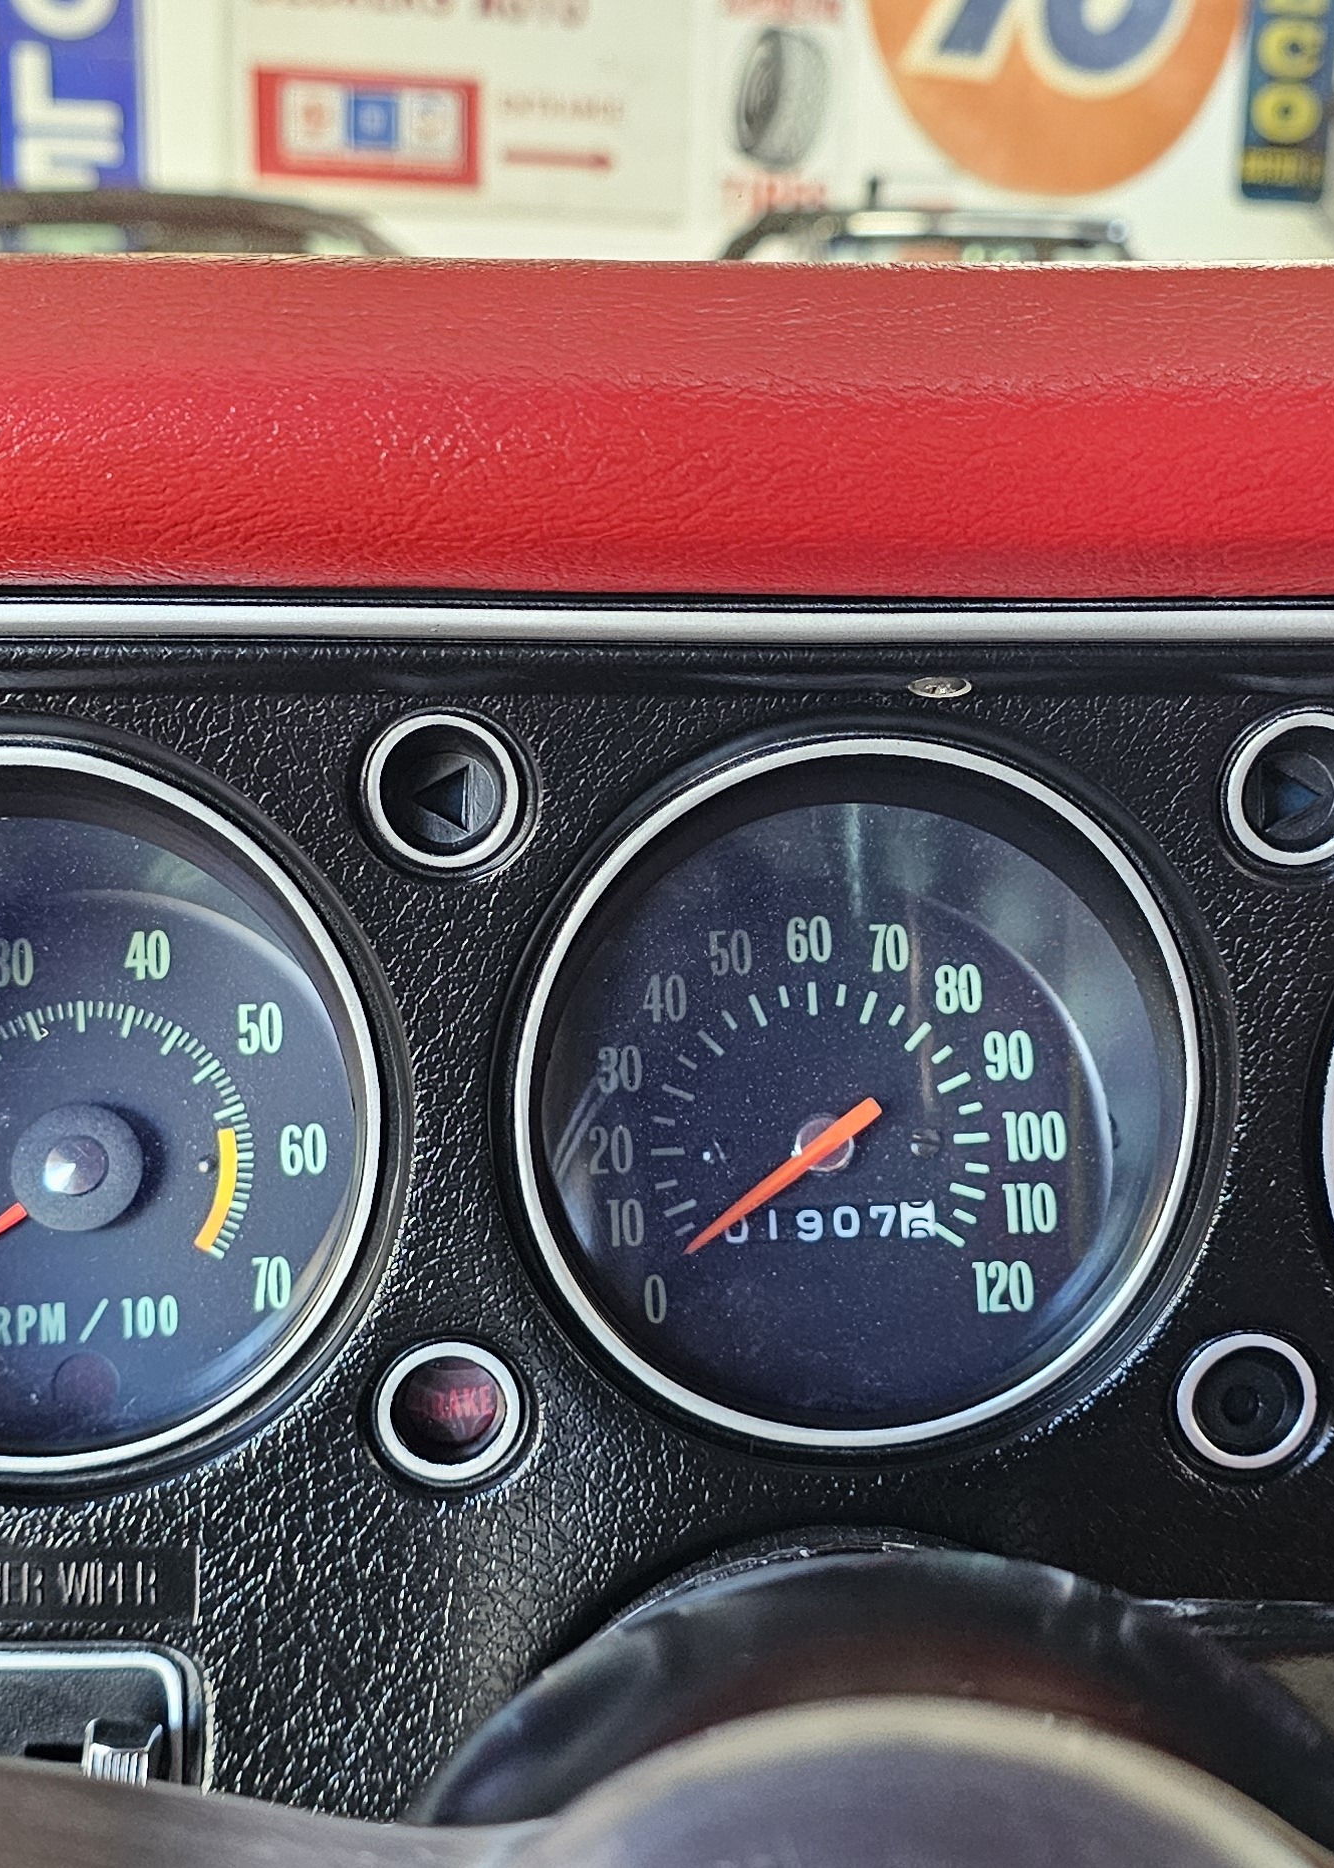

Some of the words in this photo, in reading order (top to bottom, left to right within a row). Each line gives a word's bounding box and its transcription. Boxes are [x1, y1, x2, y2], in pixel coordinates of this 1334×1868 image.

[123, 929, 170, 981] 40
[709, 929, 752, 976] 50
[786, 916, 831, 963] 60
[869, 923, 909, 972] 70
[643, 974, 687, 1022] 40
[935, 963, 982, 1013] 80
[237, 1002, 283, 1054] 50
[597, 1045, 642, 1091] 30
[984, 1029, 1034, 1081] 90
[280, 1124, 327, 1176] 60
[589, 1127, 633, 1175] 20
[1002, 1110, 1066, 1161] 100
[608, 1199, 645, 1247] 10
[1002, 1183, 1058, 1234] 110
[251, 1257, 292, 1313] 70
[644, 1274, 666, 1324] 0
[972, 1260, 1034, 1313] 120
[121, 1295, 178, 1339] 100
[58, 1558, 158, 1606] WIPER
